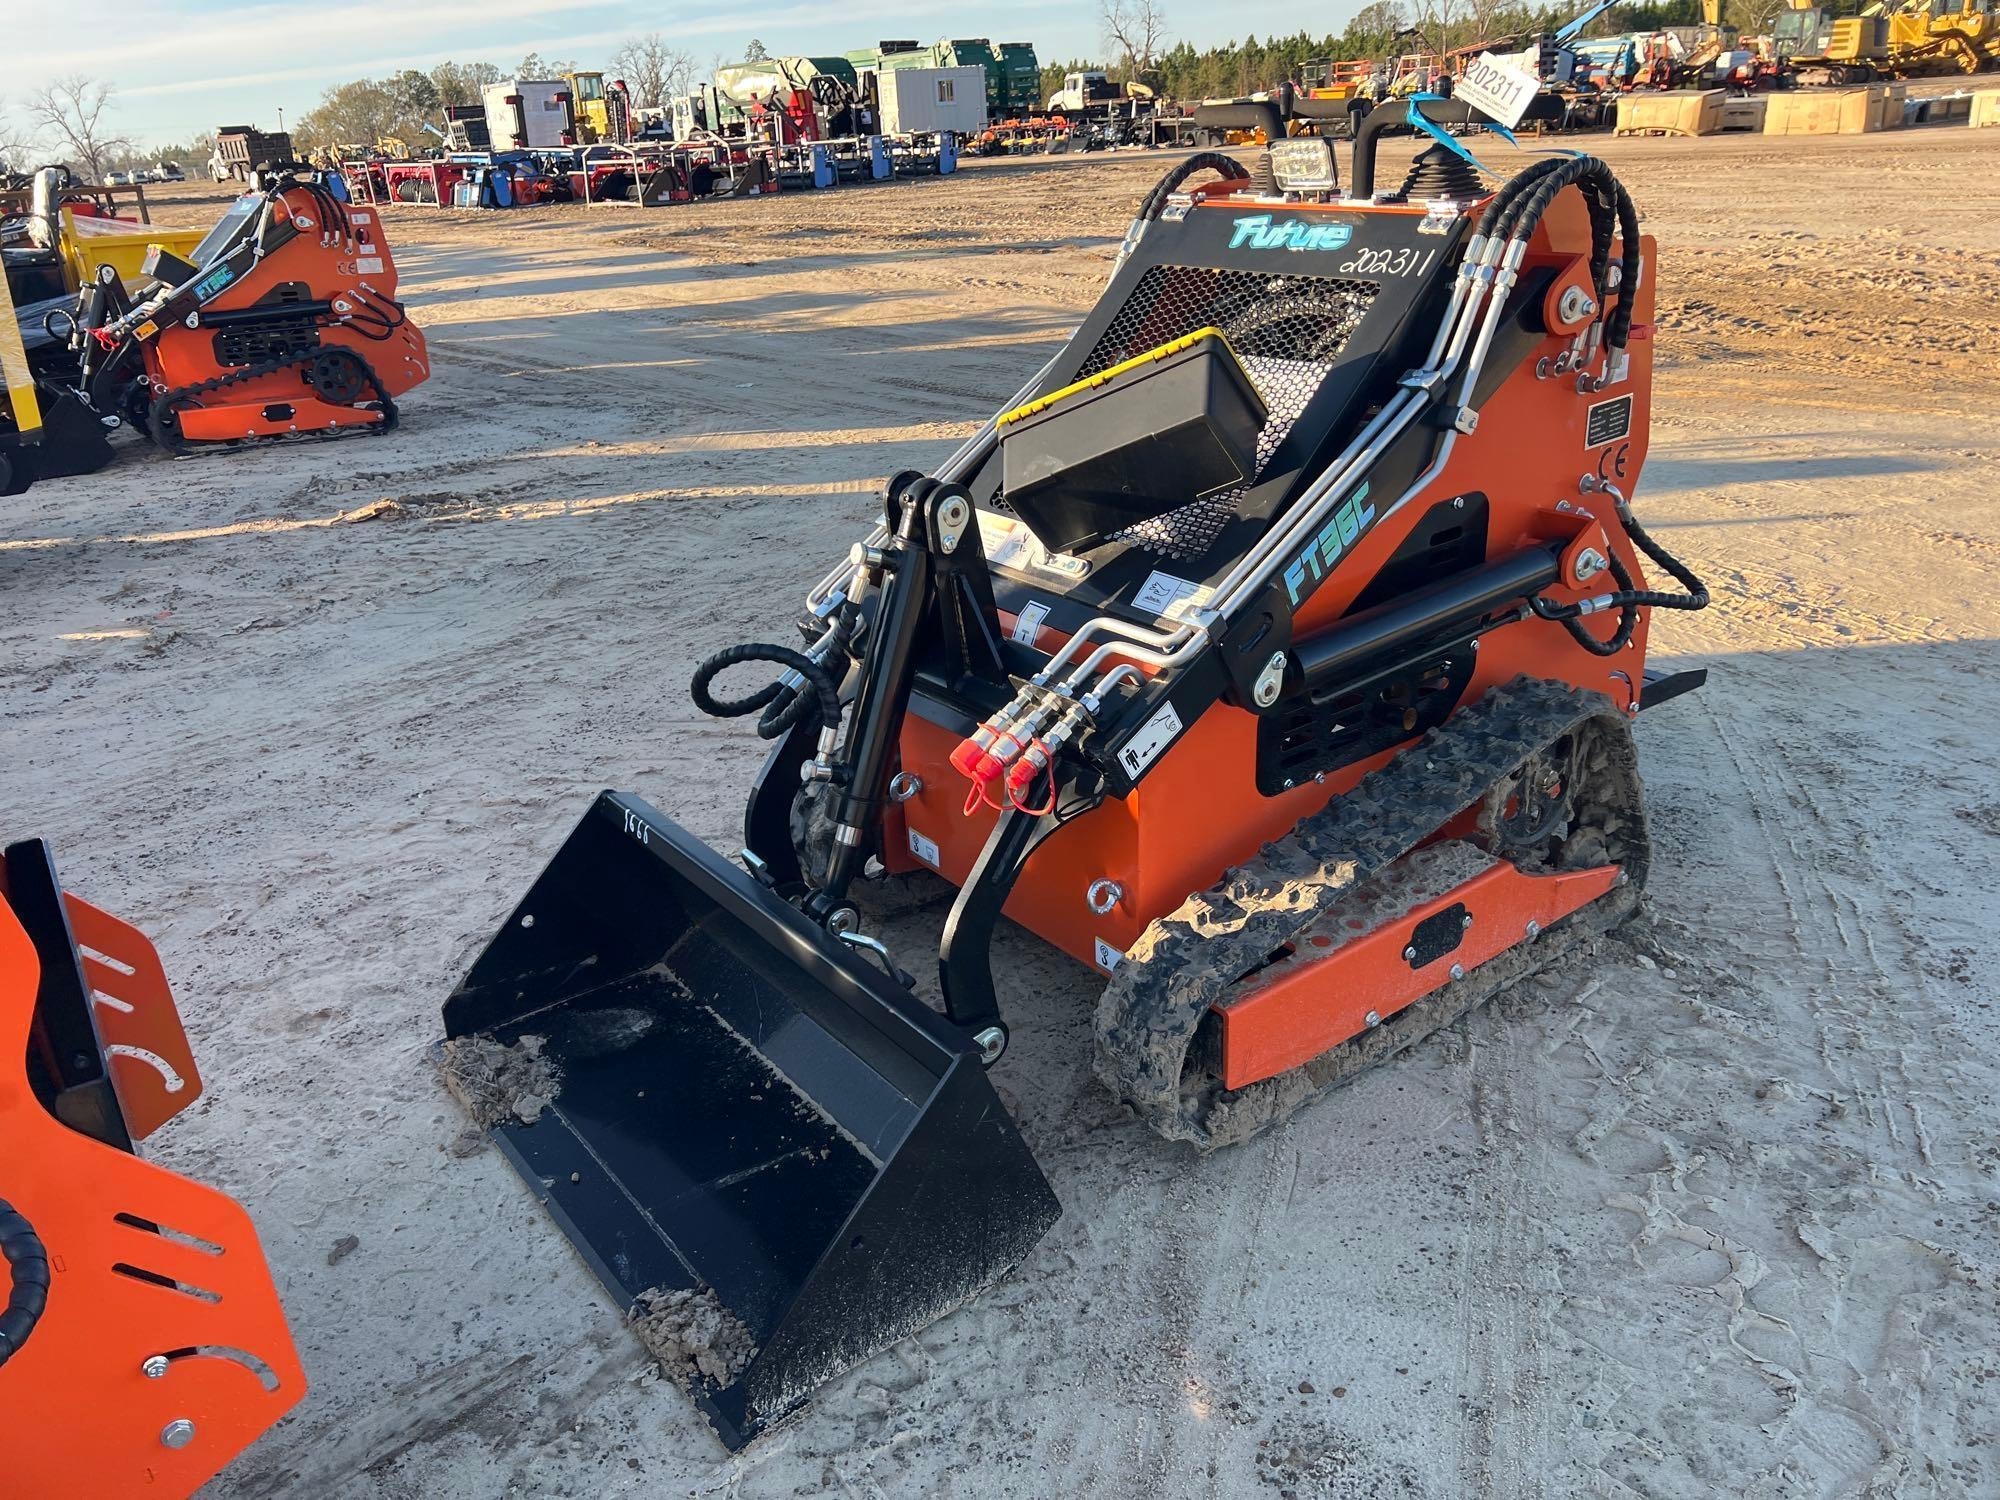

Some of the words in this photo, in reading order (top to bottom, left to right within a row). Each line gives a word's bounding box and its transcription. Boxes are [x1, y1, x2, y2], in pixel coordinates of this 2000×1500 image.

[1466, 60, 1524, 106] 202311
[1229, 214, 1354, 250] Future
[1339, 247, 1436, 278] 202311
[1283, 480, 1376, 606] FT36C
